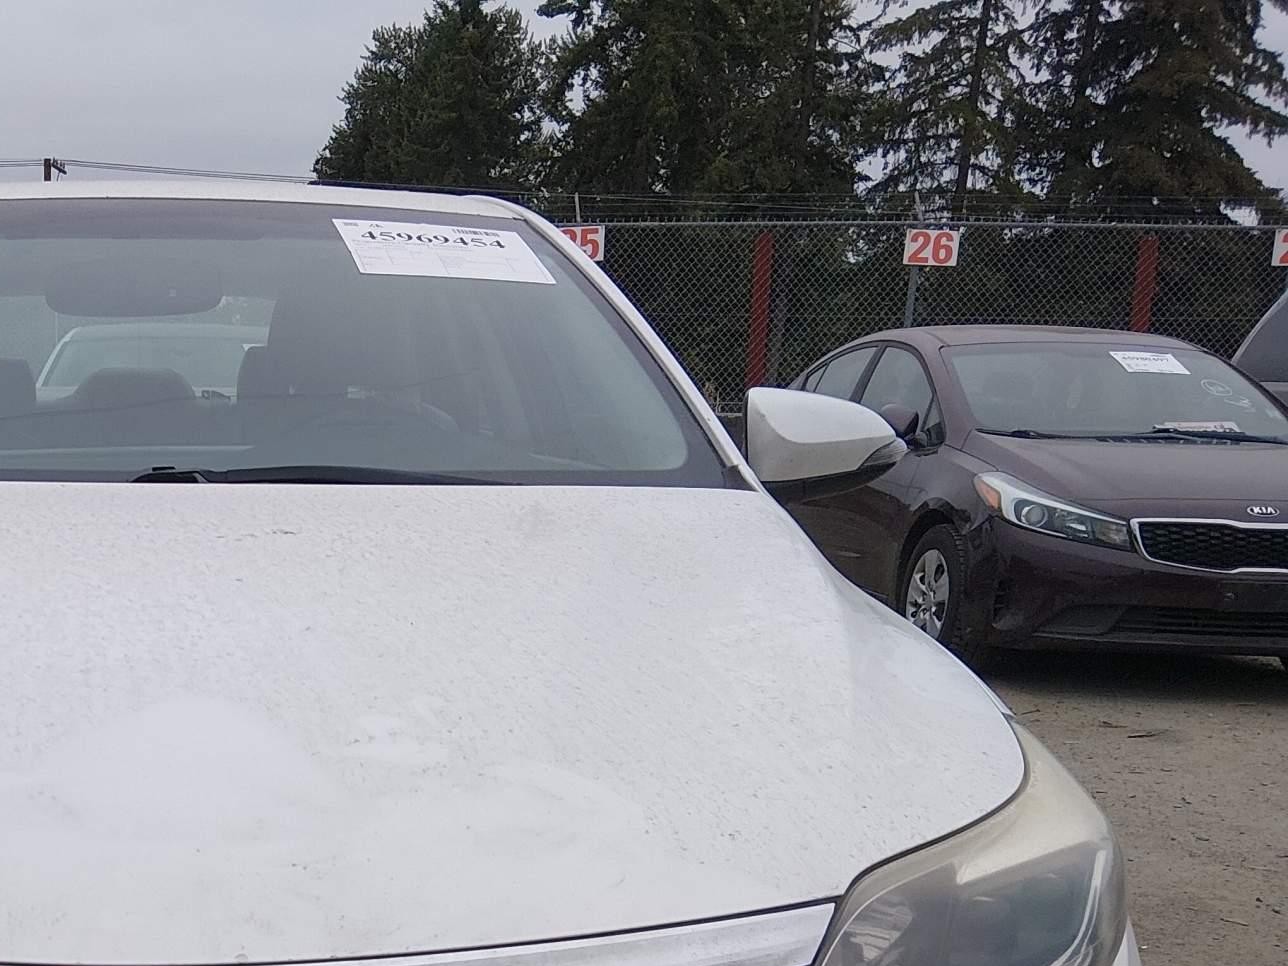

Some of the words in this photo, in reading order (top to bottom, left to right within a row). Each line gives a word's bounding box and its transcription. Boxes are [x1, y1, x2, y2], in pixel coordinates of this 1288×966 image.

[361, 230, 506, 249] 45969454
[908, 231, 954, 264] 26
[1253, 506, 1276, 514] KIA
